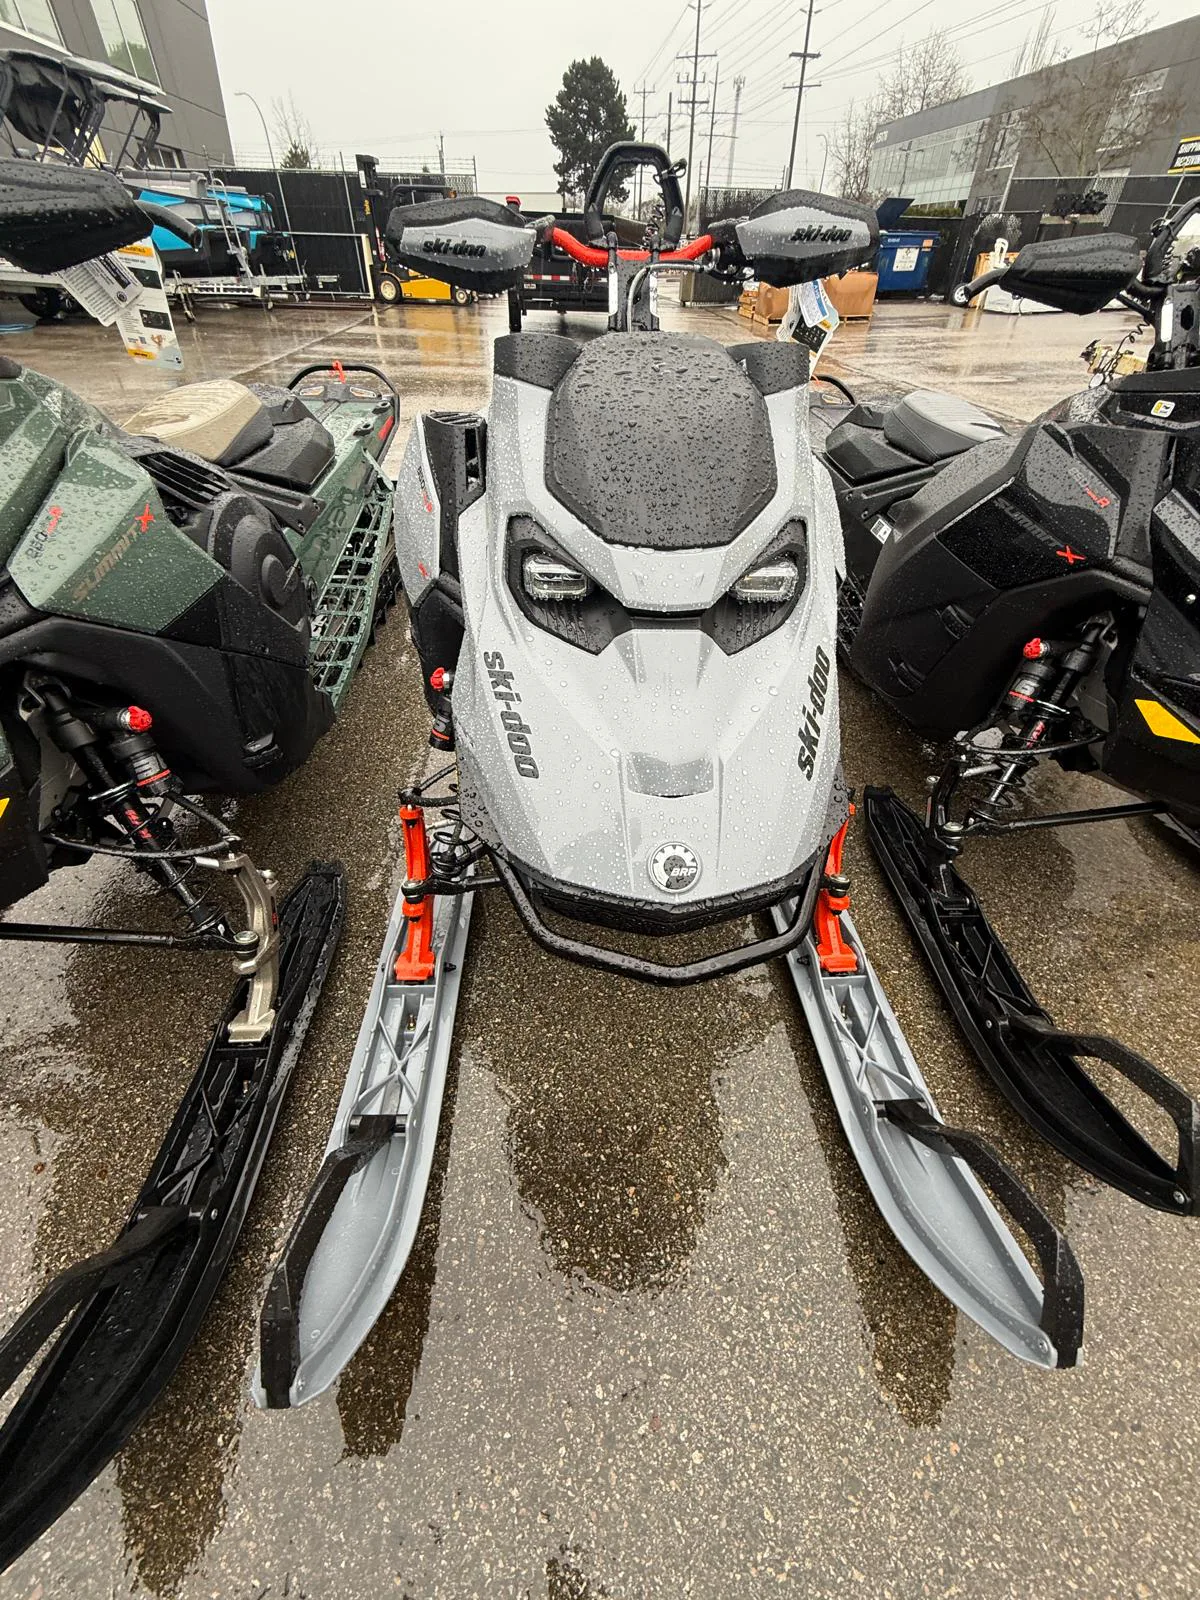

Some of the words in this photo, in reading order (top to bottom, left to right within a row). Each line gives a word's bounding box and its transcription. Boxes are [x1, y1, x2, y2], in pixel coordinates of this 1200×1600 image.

[790, 224, 853, 242] ski-doo
[422, 238, 488, 257] ski-doo
[483, 651, 540, 780] ski-doo
[797, 645, 830, 782] ski-doo
[670, 867, 698, 877] BRP
